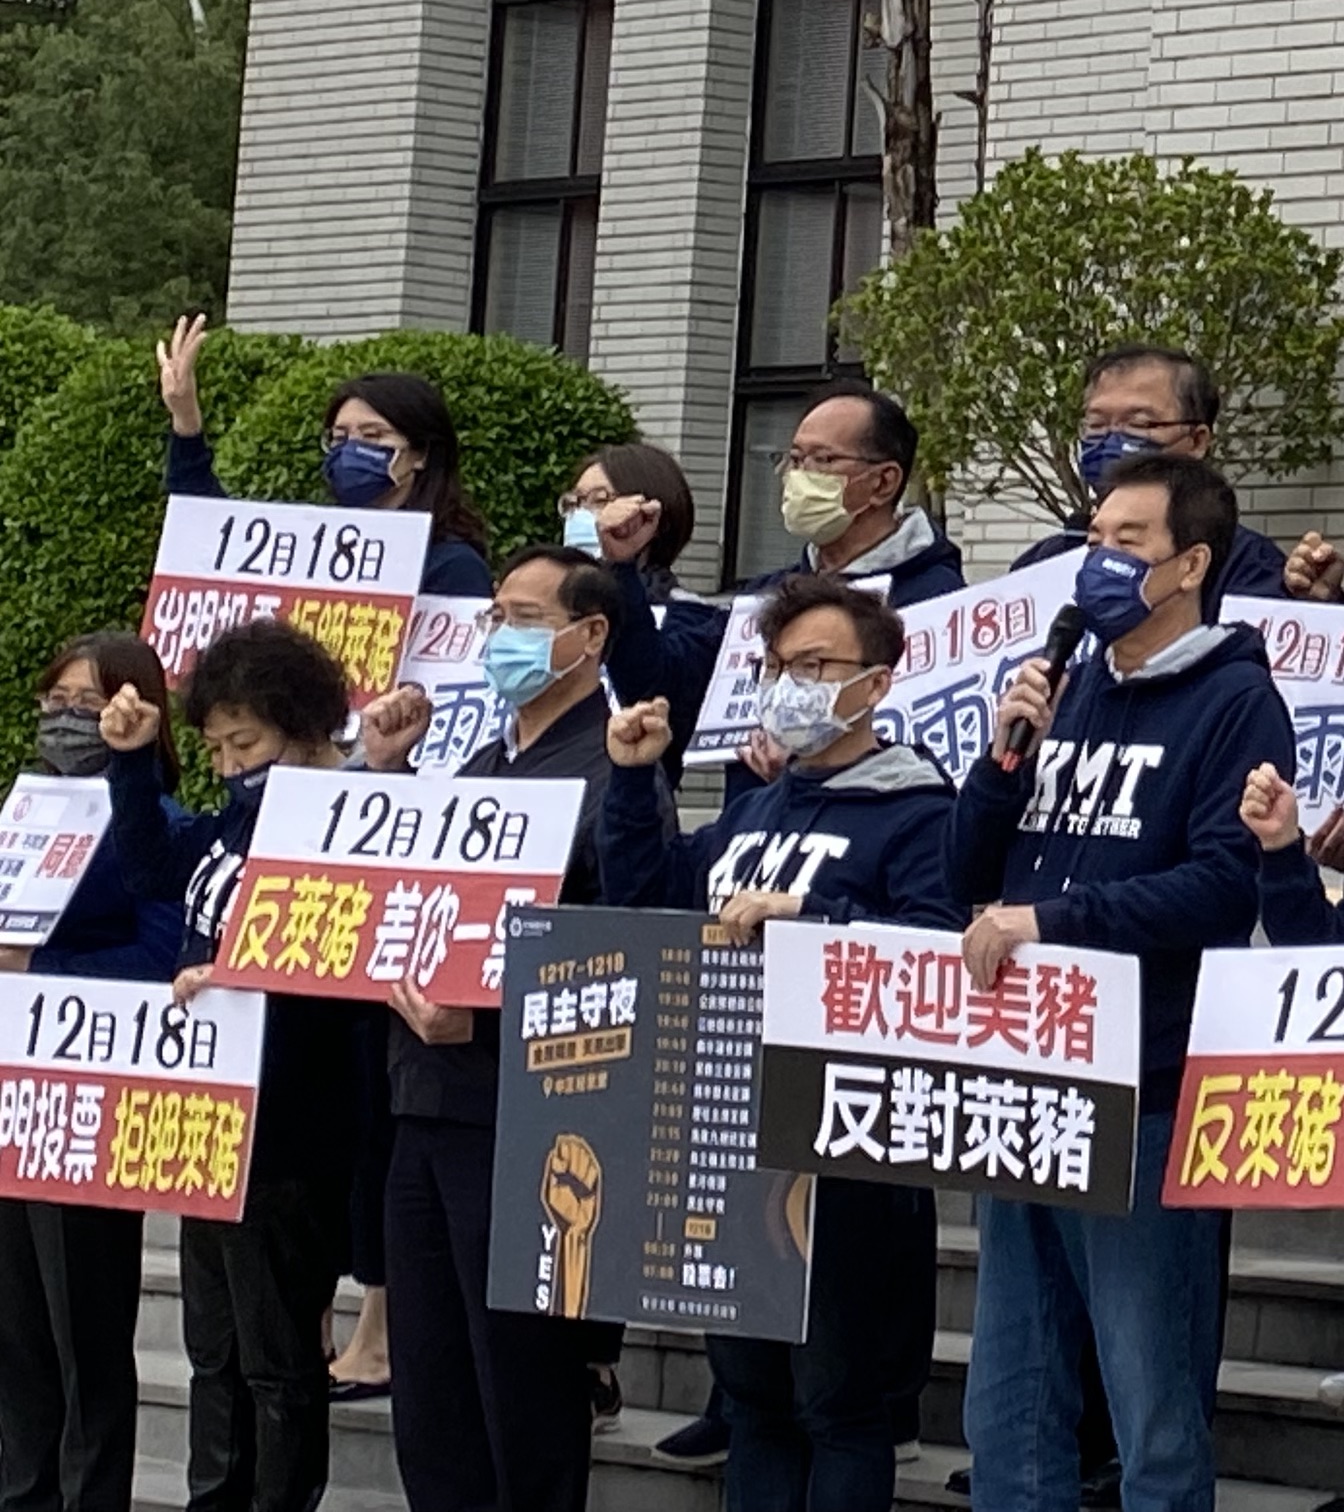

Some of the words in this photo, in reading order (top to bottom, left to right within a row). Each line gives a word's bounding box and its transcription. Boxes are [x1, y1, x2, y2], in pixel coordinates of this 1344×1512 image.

[214, 515, 385, 583] 12月18日
[897, 598, 1030, 671] 月18日
[1026, 738, 1164, 817] KMT
[321, 789, 529, 862] 12月18日
[707, 831, 849, 895] KMT
[228, 874, 372, 979] 反萊豬
[26, 991, 217, 1069] 12月18日
[521, 976, 638, 1040] 民主守夜
[820, 939, 1098, 1064] 歡迎美豬
[813, 1060, 1095, 1191] 反對萊豬
